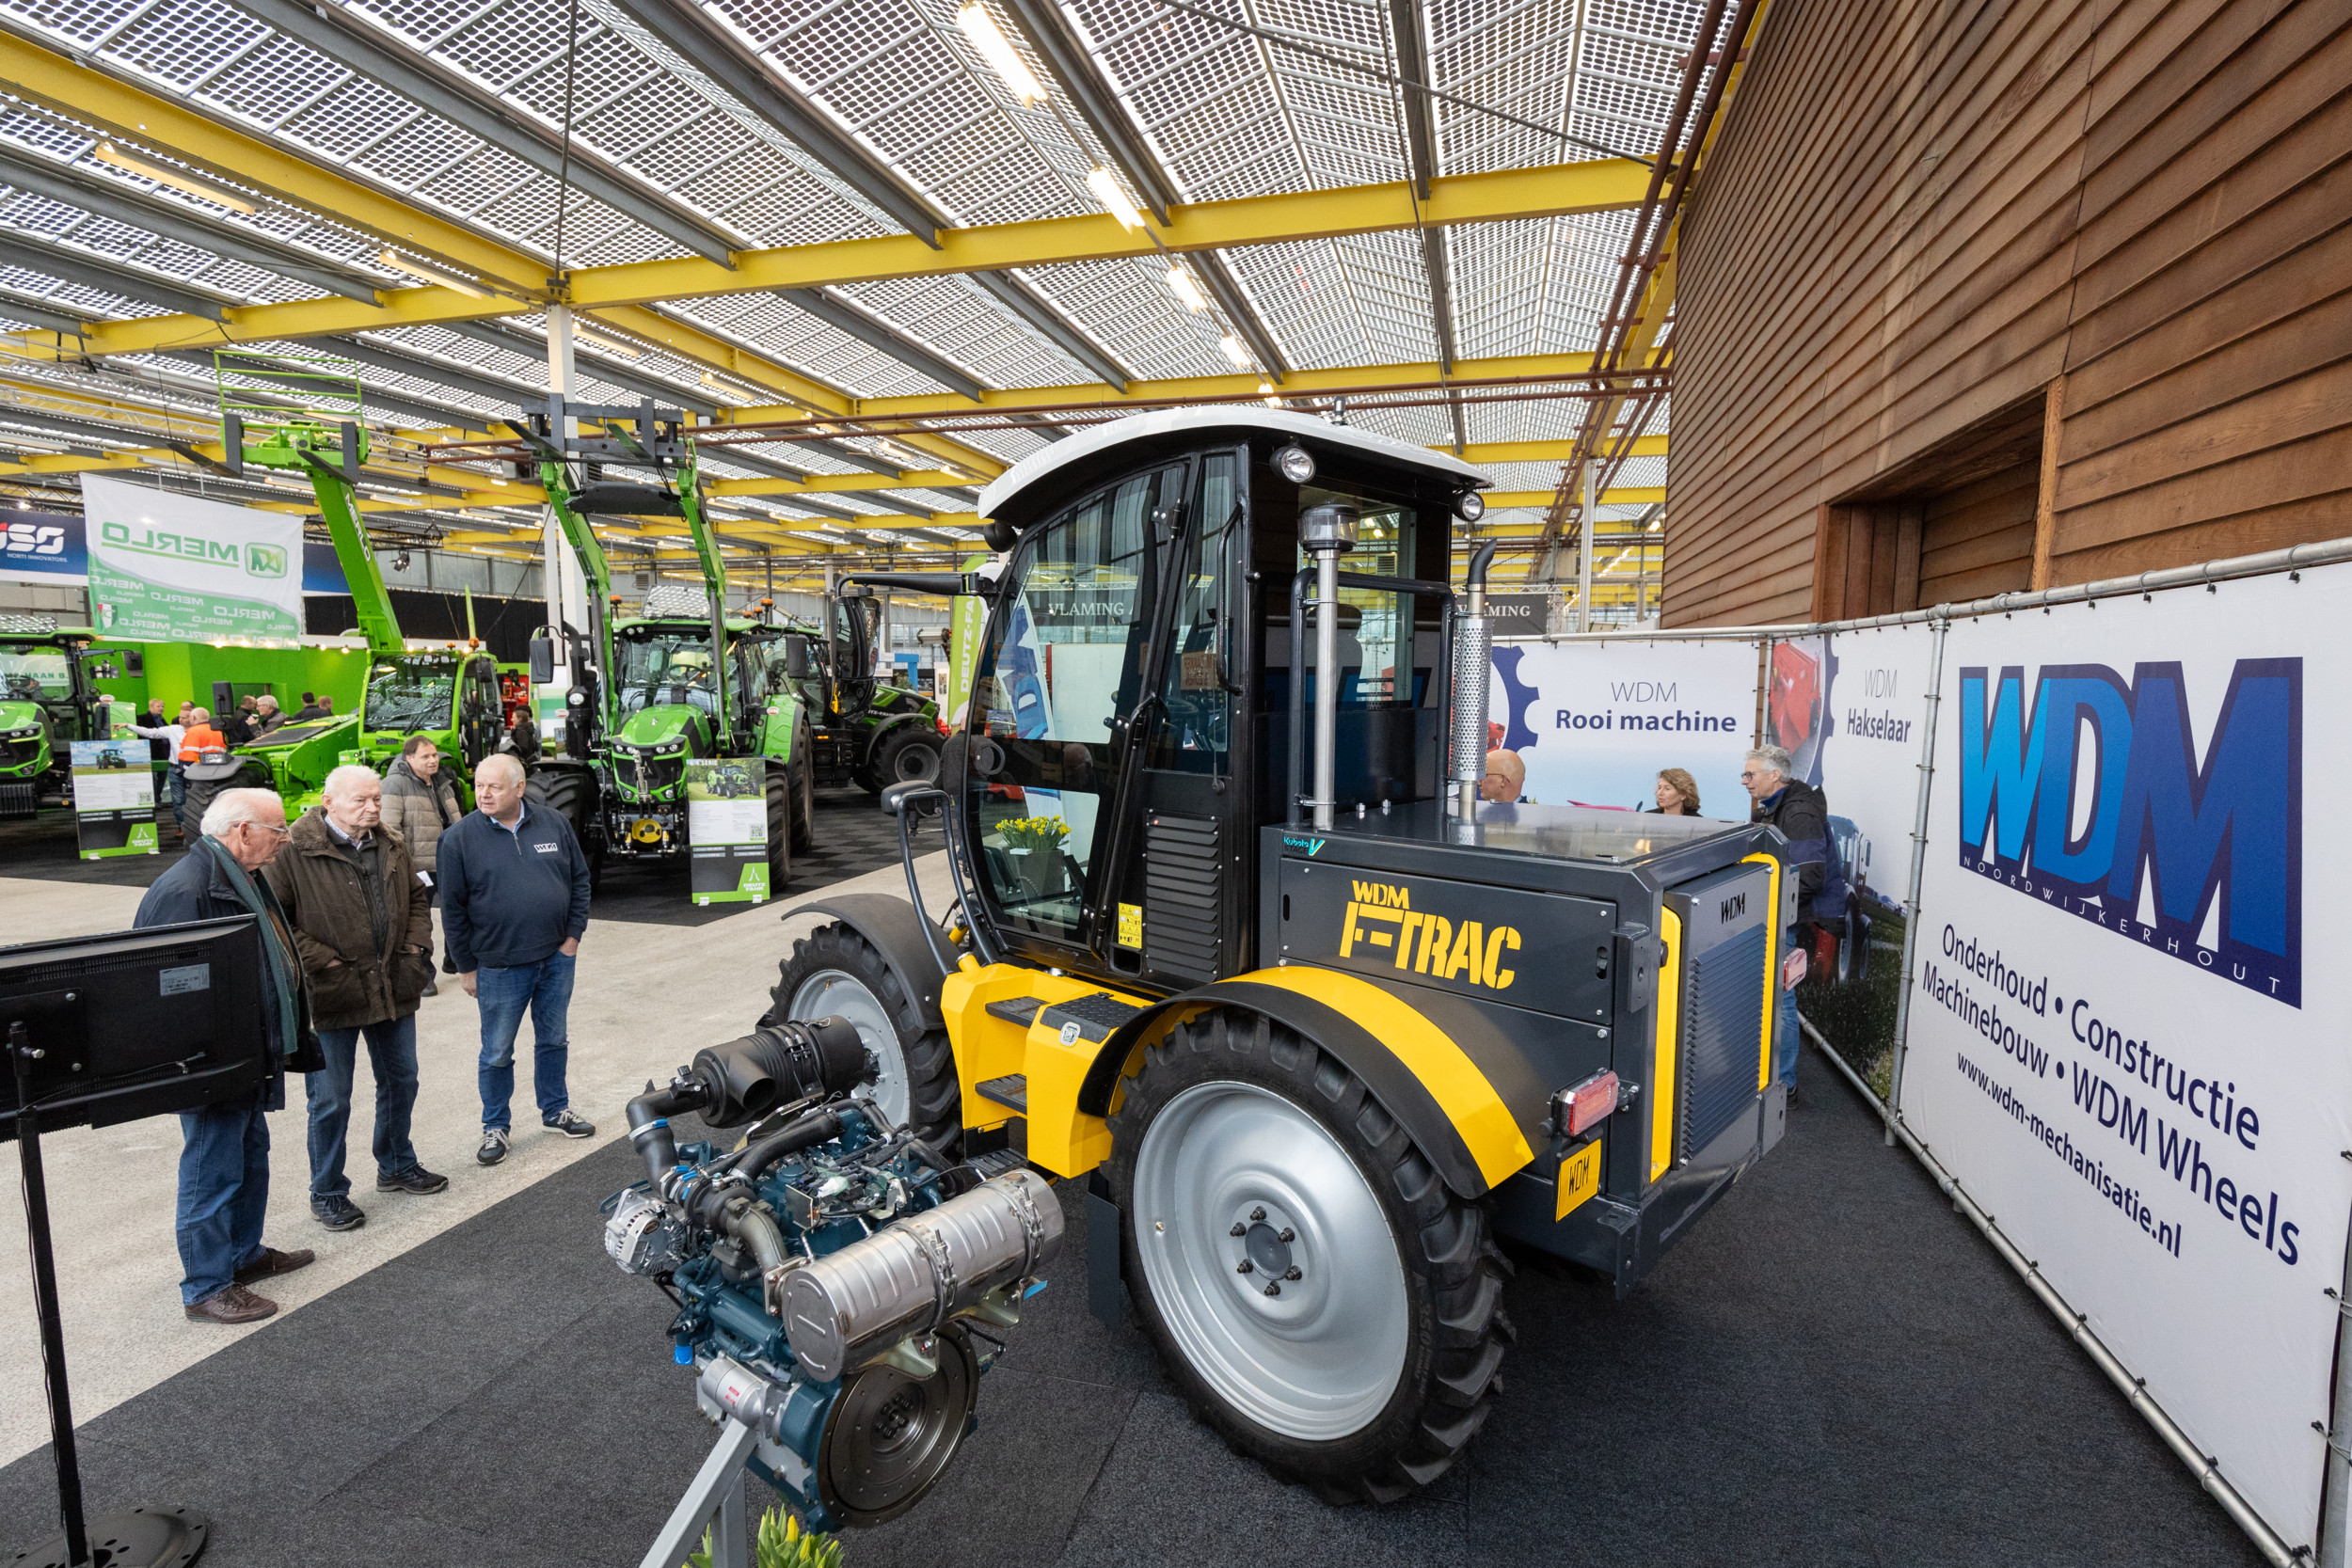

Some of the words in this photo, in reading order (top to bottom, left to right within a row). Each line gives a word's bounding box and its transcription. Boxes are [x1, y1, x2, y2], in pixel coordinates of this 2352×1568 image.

[345, 492, 371, 562] MERLO
[1048, 601, 1124, 617] VLAMING
[1457, 604, 1531, 617] VMING
[961, 596, 976, 693] DEUTZ-FA
[1611, 682, 1677, 703] WDM
[1865, 669, 1898, 698] WDM
[1556, 709, 1613, 731] Rooi
[1620, 710, 1737, 733] machine
[1847, 707, 1912, 743] Hakselaar
[1960, 657, 2303, 959] WDM
[1283, 836, 1310, 847] Kubota
[1284, 846, 1308, 854] STAGE
[1308, 837, 1326, 856] V
[1352, 879, 1410, 910] WDM
[1721, 893, 1745, 925] WDM
[1963, 856, 2280, 993] NOORDWIJKERHOUT
[1339, 901, 1522, 990] F-TRAC
[1942, 924, 2048, 1017] Onderhoud
[2071, 999, 2260, 1151] Constructie
[1922, 960, 2049, 1079] Machinebouw
[2073, 1060, 2148, 1155] WDM
[2157, 1117, 2300, 1266] Wheels
[1958, 1052, 2182, 1259] www.wdm-mechanisatie.nl
[1567, 1154, 1590, 1196] WDM
